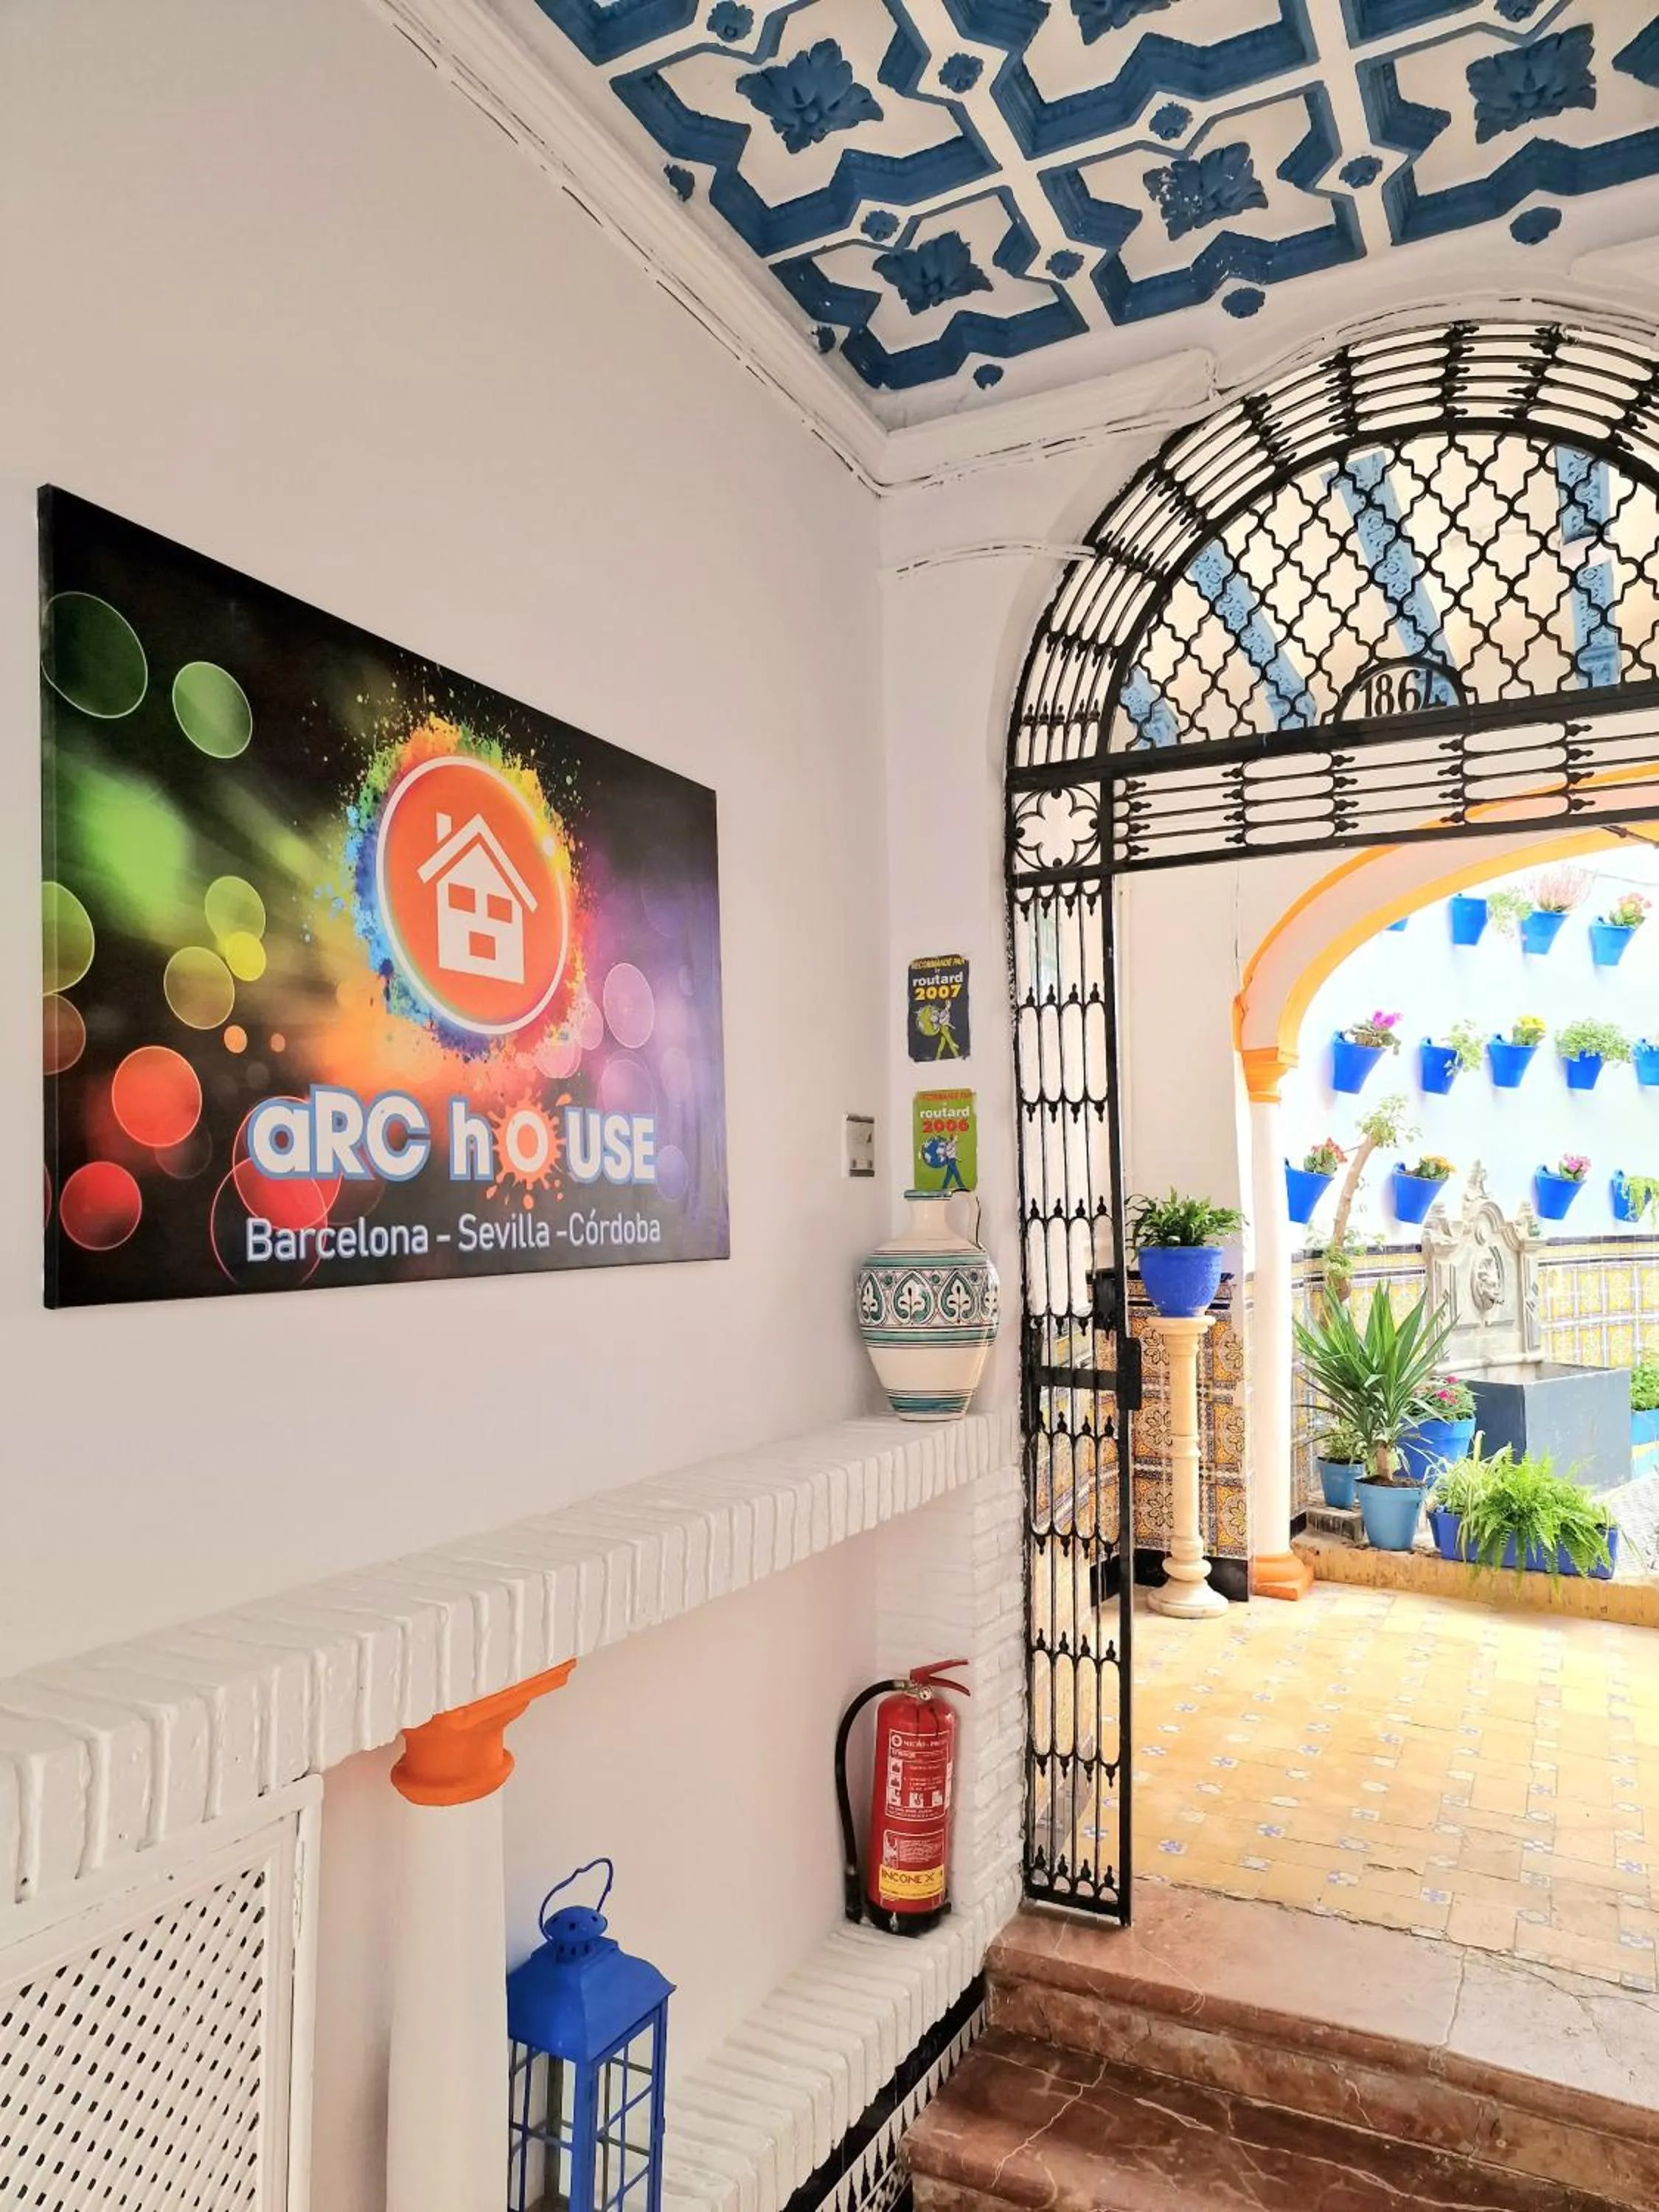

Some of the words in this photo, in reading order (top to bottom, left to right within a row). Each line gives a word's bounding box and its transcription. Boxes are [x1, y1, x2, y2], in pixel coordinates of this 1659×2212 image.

[913, 972, 963, 987] routard
[914, 984, 961, 1000] 2007
[919, 1105, 970, 1118] routard
[247, 1085, 431, 1180] aRC
[246, 1217, 428, 1262] Barcelona
[458, 1213, 550, 1251] Sevilla
